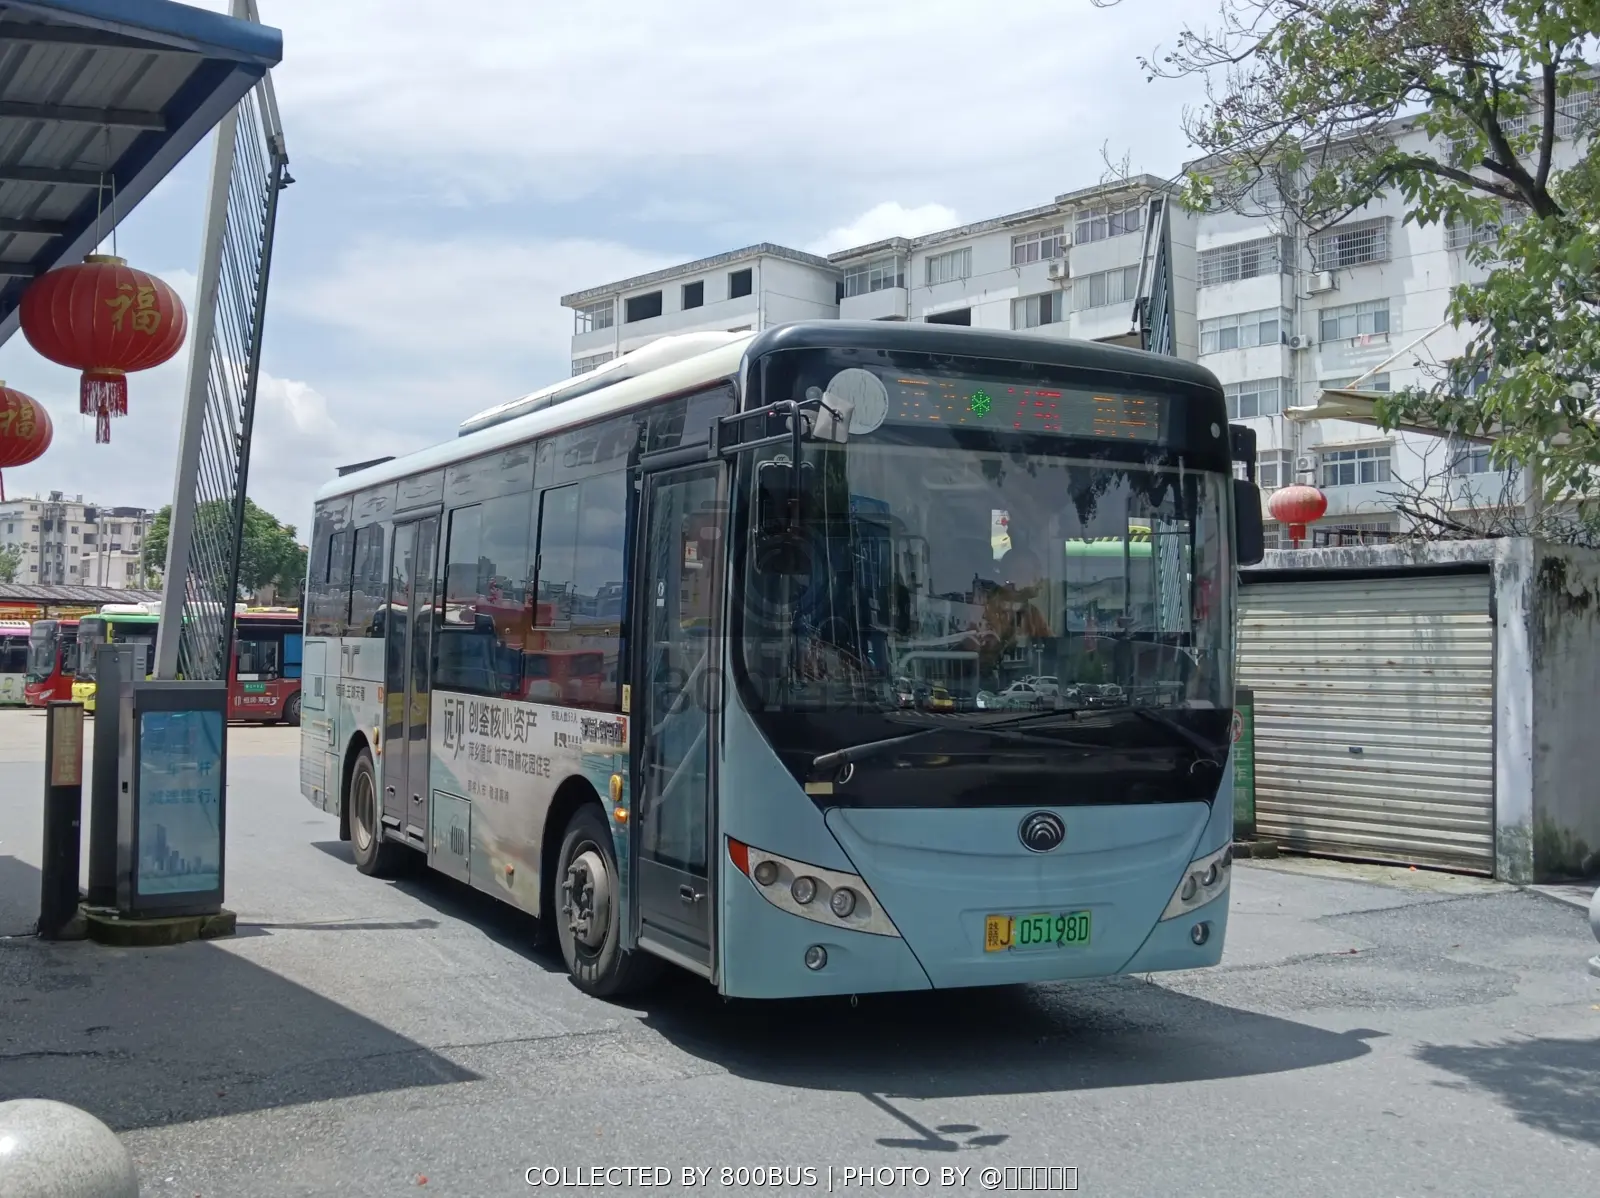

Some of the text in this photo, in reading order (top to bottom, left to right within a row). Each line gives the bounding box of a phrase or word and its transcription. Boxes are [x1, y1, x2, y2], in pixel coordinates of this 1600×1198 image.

[105, 284, 162, 335] 福
[0, 401, 37, 441] 福
[443, 697, 466, 761] 远见
[468, 701, 537, 743] 创鉴核心资产
